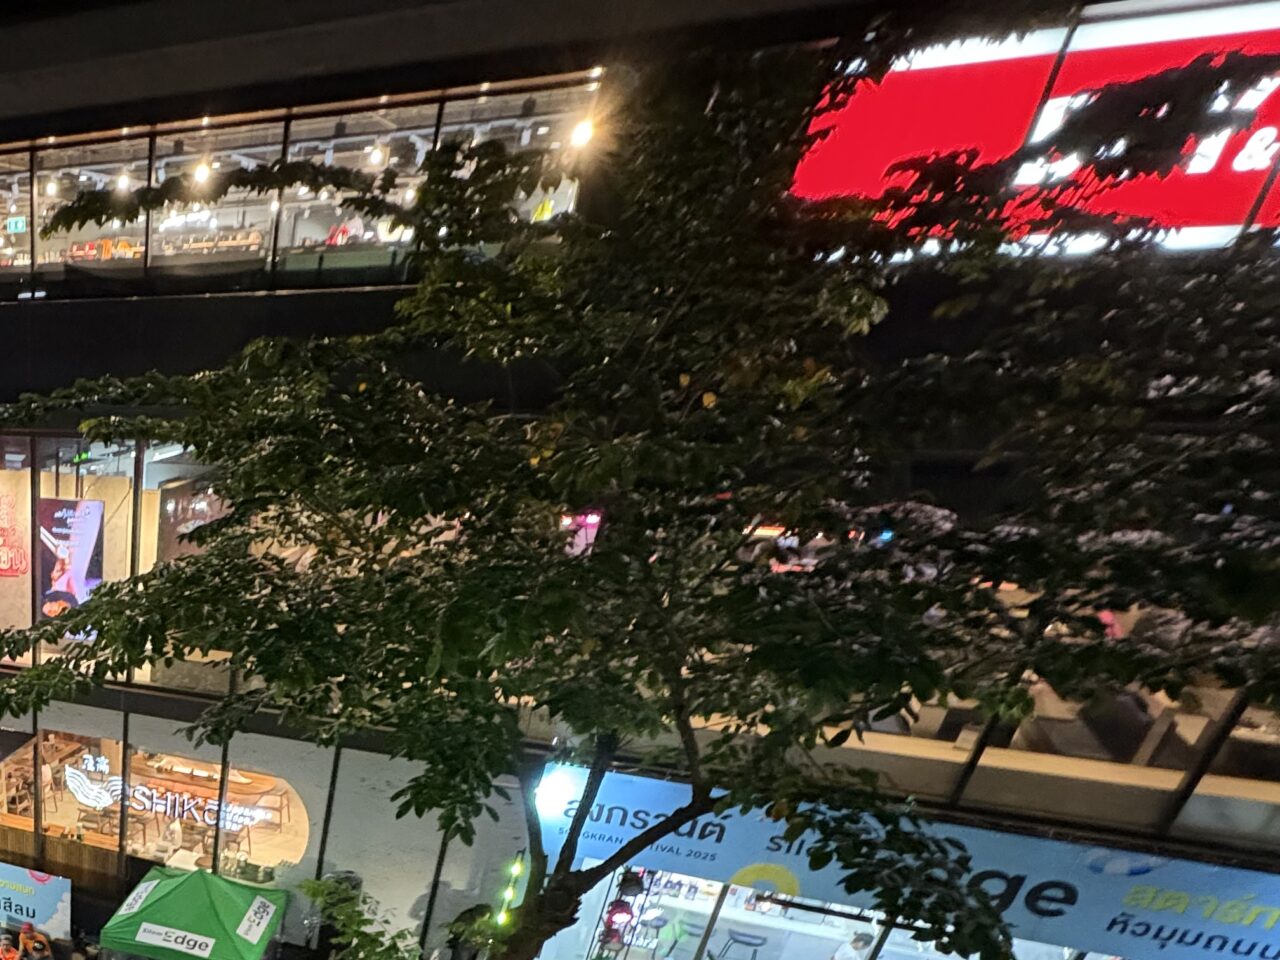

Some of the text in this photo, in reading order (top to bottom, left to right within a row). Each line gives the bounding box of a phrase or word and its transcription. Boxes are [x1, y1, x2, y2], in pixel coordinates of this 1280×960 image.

[558, 827, 624, 845] SGKRAN
[685, 848, 717, 861] 2025
[162, 930, 210, 952] Edge
